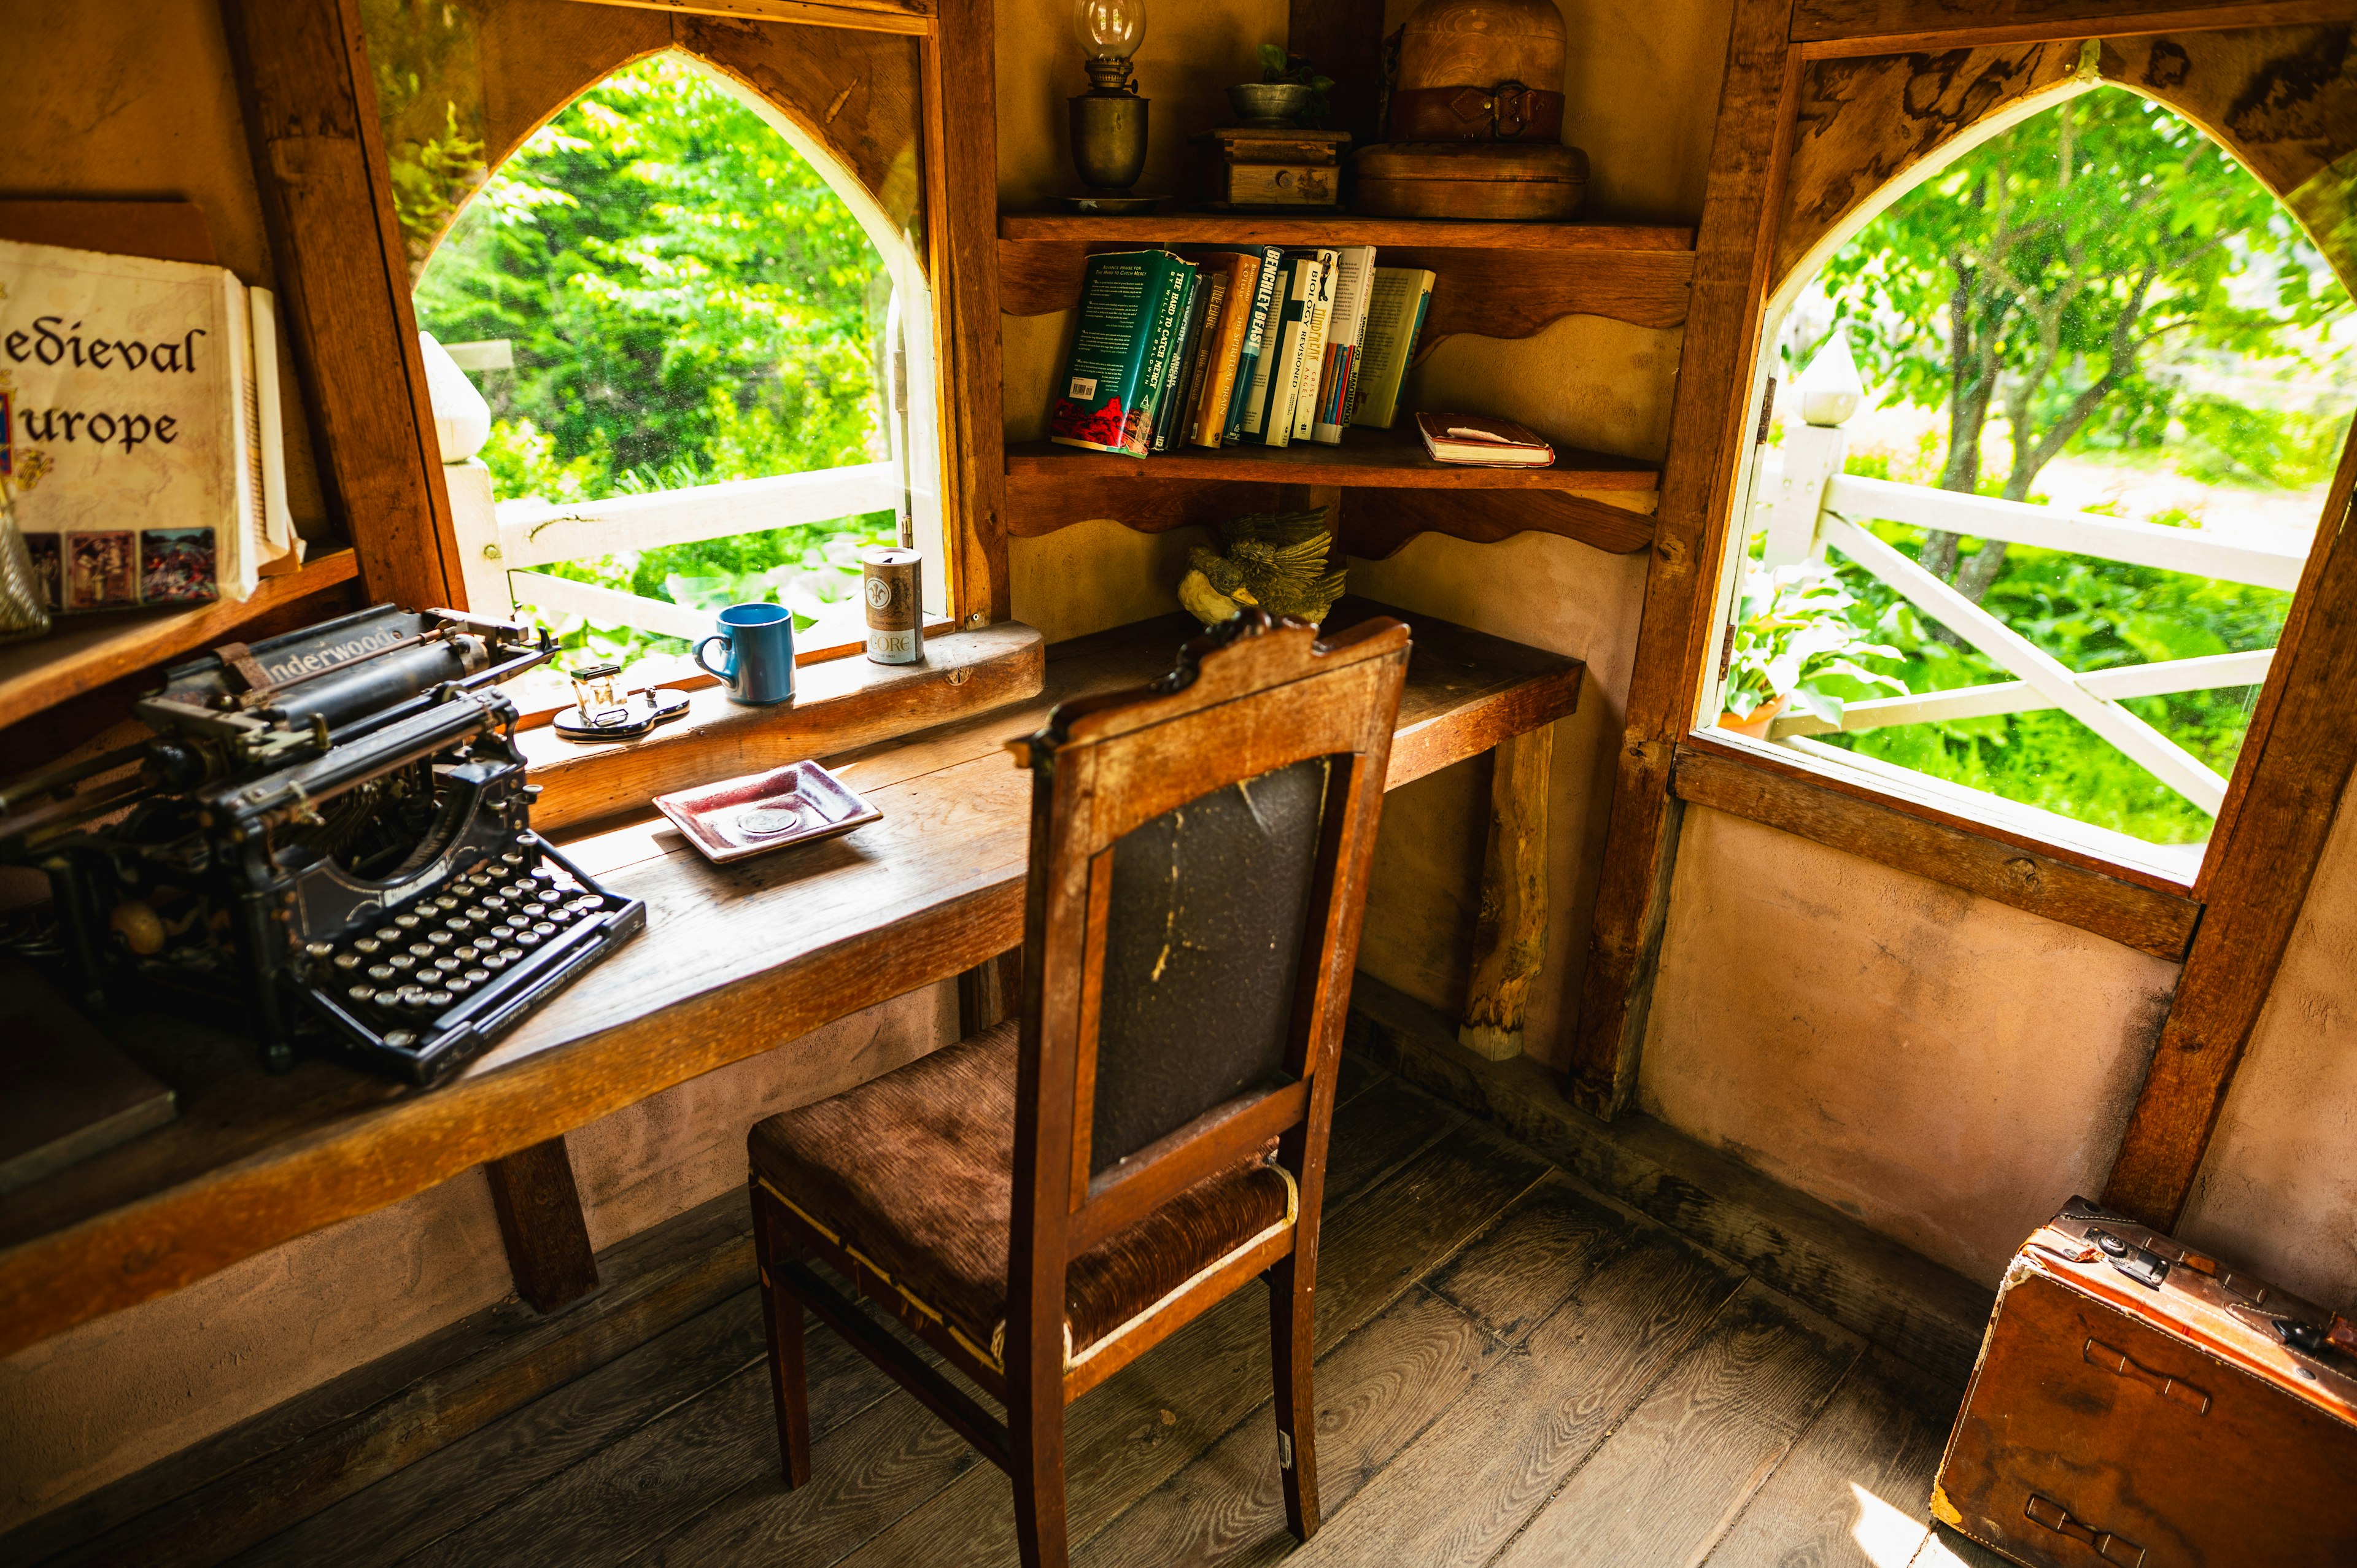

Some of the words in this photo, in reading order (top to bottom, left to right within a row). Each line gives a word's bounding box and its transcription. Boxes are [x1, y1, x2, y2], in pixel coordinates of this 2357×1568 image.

[1169, 271, 1175, 283] BY
[1174, 272, 1185, 291] THE
[1239, 271, 1248, 298] O'LEARY
[1245, 264, 1257, 301] BEAUREGARD
[1256, 249, 1280, 312] BENCHLEY
[1167, 292, 1178, 315] HARD
[1211, 285, 1226, 304] THE
[1304, 270, 1318, 328] BIOLOGY
[1157, 290, 1171, 333] WILLIAM
[1165, 317, 1173, 328] TO
[1206, 304, 1221, 330] EDGE
[4, 316, 207, 374] edieval
[1156, 329, 1170, 358] CATCH
[1248, 311, 1267, 350] BEAST
[1306, 309, 1326, 361] MINDFREAK
[1145, 339, 1159, 384] BALDWIN
[1166, 352, 1177, 389] PADGETT
[1171, 355, 1181, 387] ABIGAIL
[1198, 350, 1209, 368] DICK
[1225, 333, 1240, 382] SPIRITUAL
[1293, 331, 1306, 388] REVISIONED
[1150, 360, 1163, 389] MERCY
[1191, 369, 1204, 401] FRANCIS
[1301, 367, 1310, 399] ANGEL
[1219, 385, 1230, 415] BRAIN
[259, 625, 401, 684] nderwood
